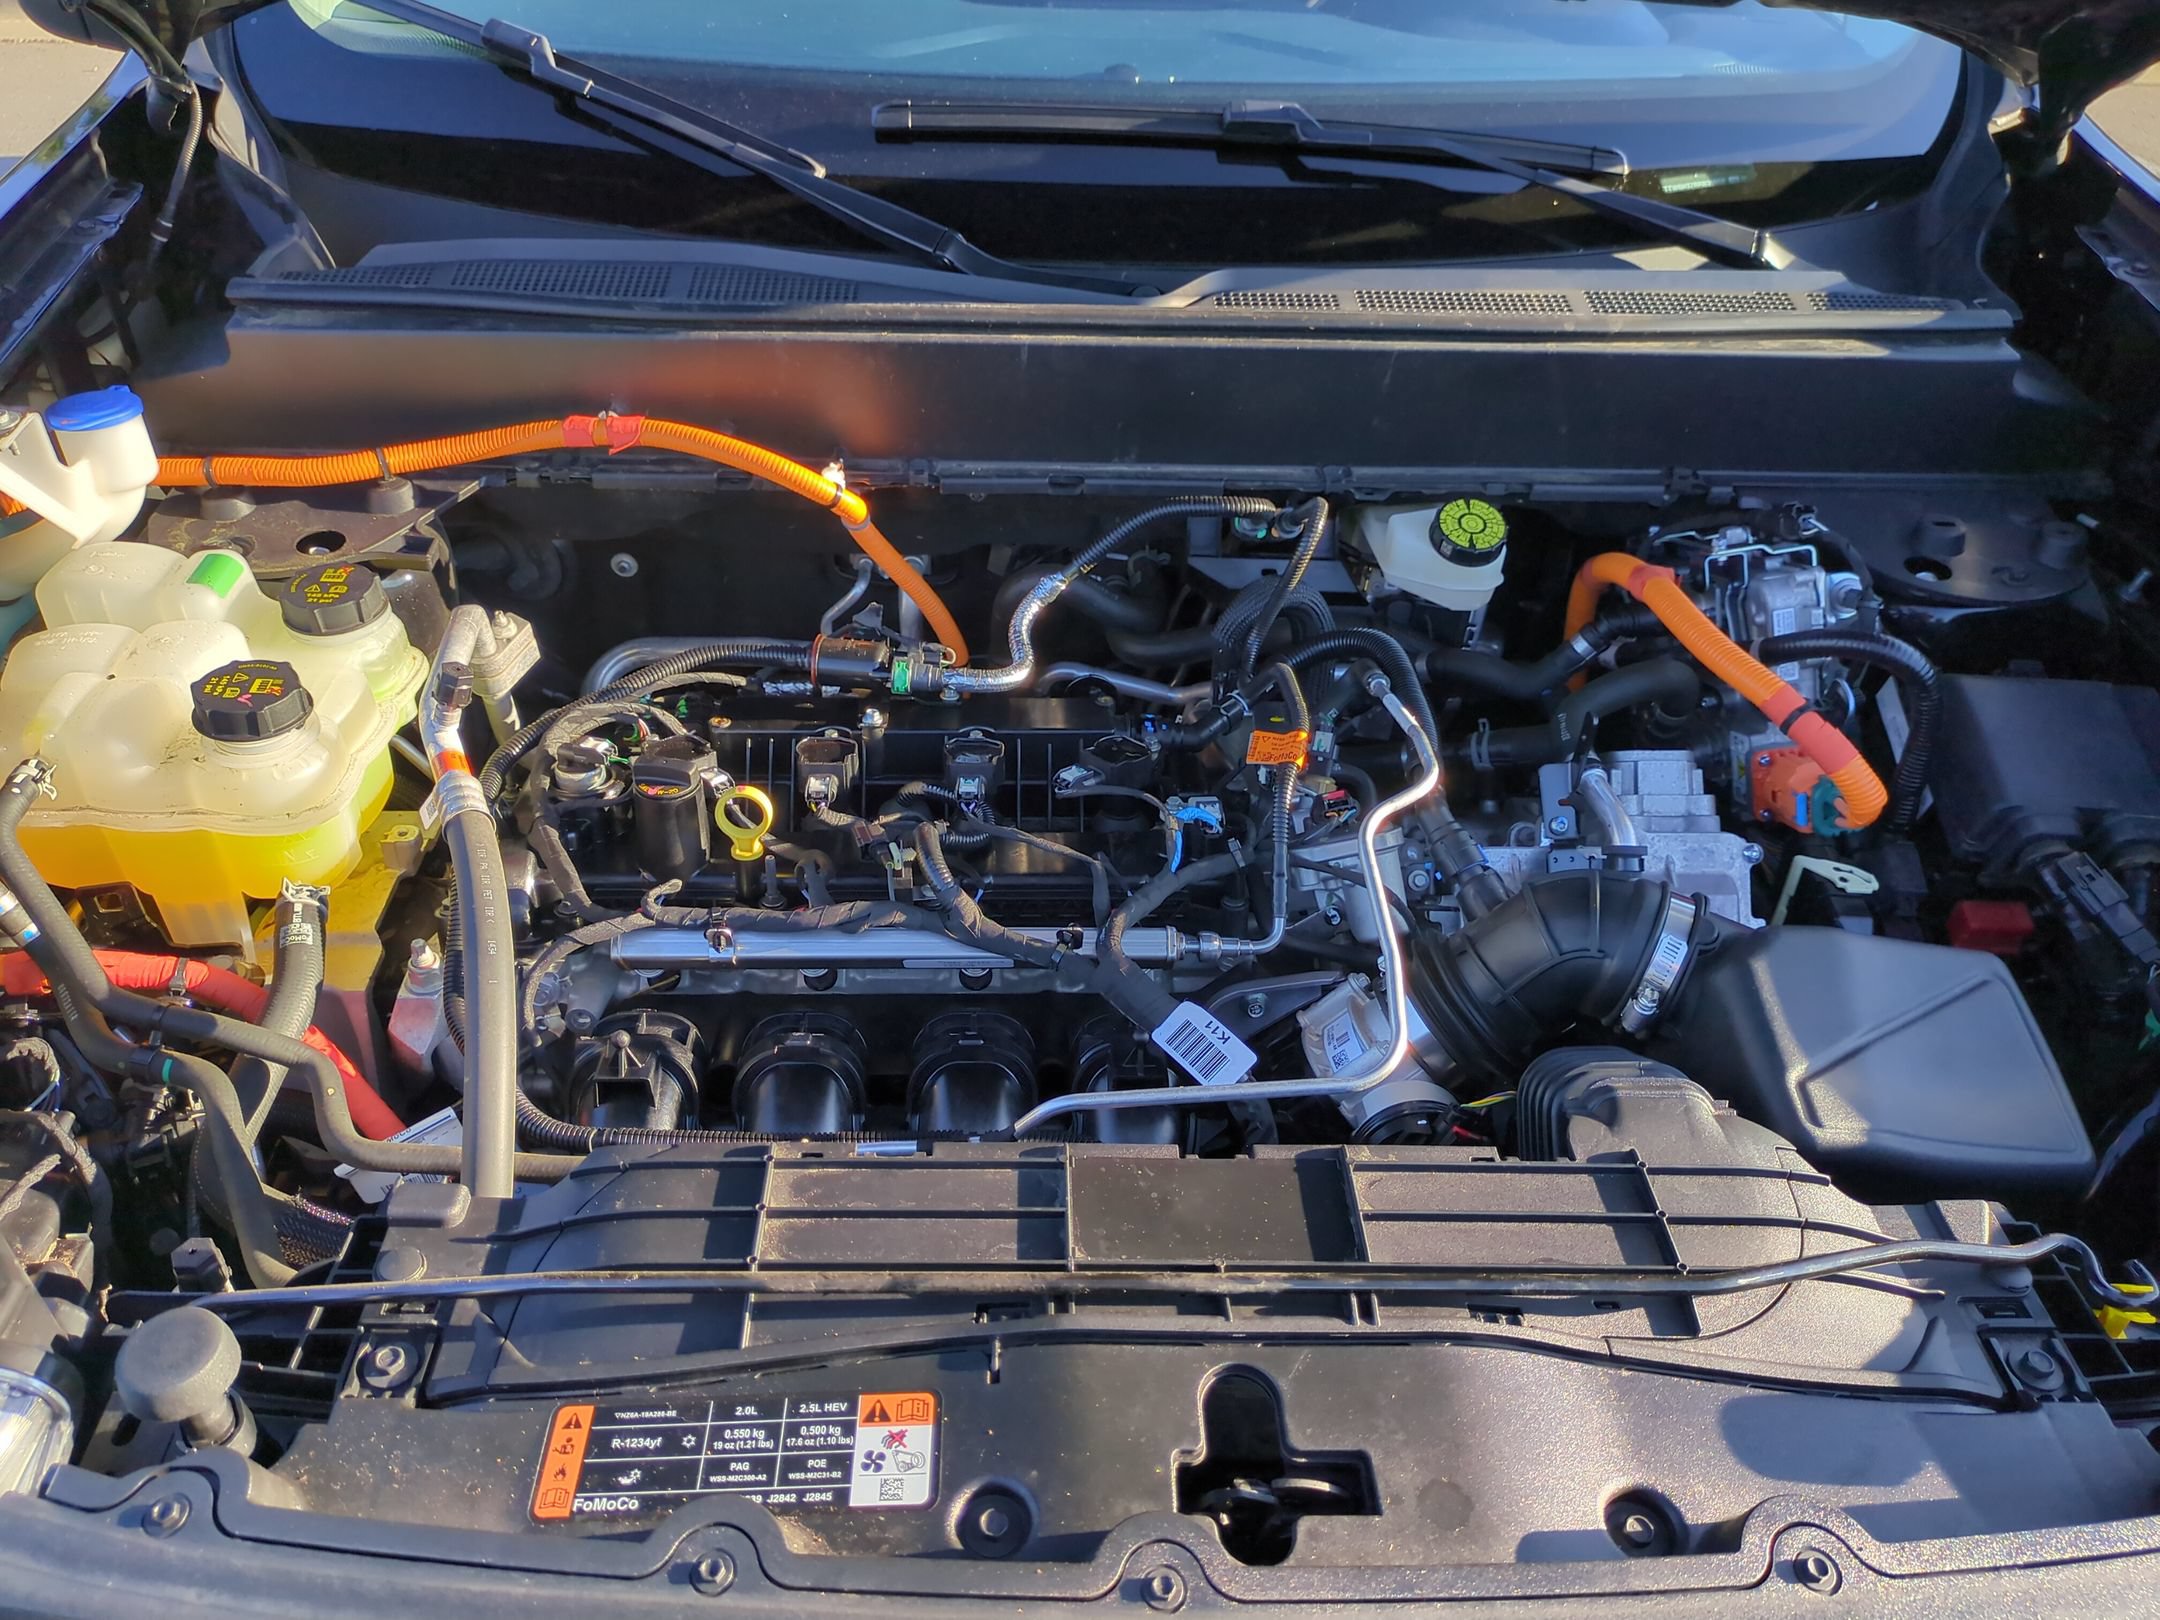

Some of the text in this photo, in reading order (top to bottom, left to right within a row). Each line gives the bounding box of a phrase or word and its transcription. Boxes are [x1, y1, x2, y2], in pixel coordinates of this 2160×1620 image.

[1204, 1019, 1231, 1045] K11
[735, 1405, 758, 1416] 2.0L
[799, 1402, 848, 1413] 2.5L HEV
[724, 1428, 765, 1440] 0.550 kg
[800, 1424, 841, 1436] 0.500 kg
[611, 1436, 663, 1450] R-1234yf
[713, 1439, 774, 1451] 19 oz (1.21 lbs)
[785, 1435, 854, 1447] 17.6 oz (1.10 lbs)
[729, 1462, 750, 1471] PAG
[807, 1459, 828, 1468] POE
[766, 1493, 797, 1503] J2842
[802, 1491, 833, 1502] J2845
[572, 1496, 640, 1512] FoMoCo
